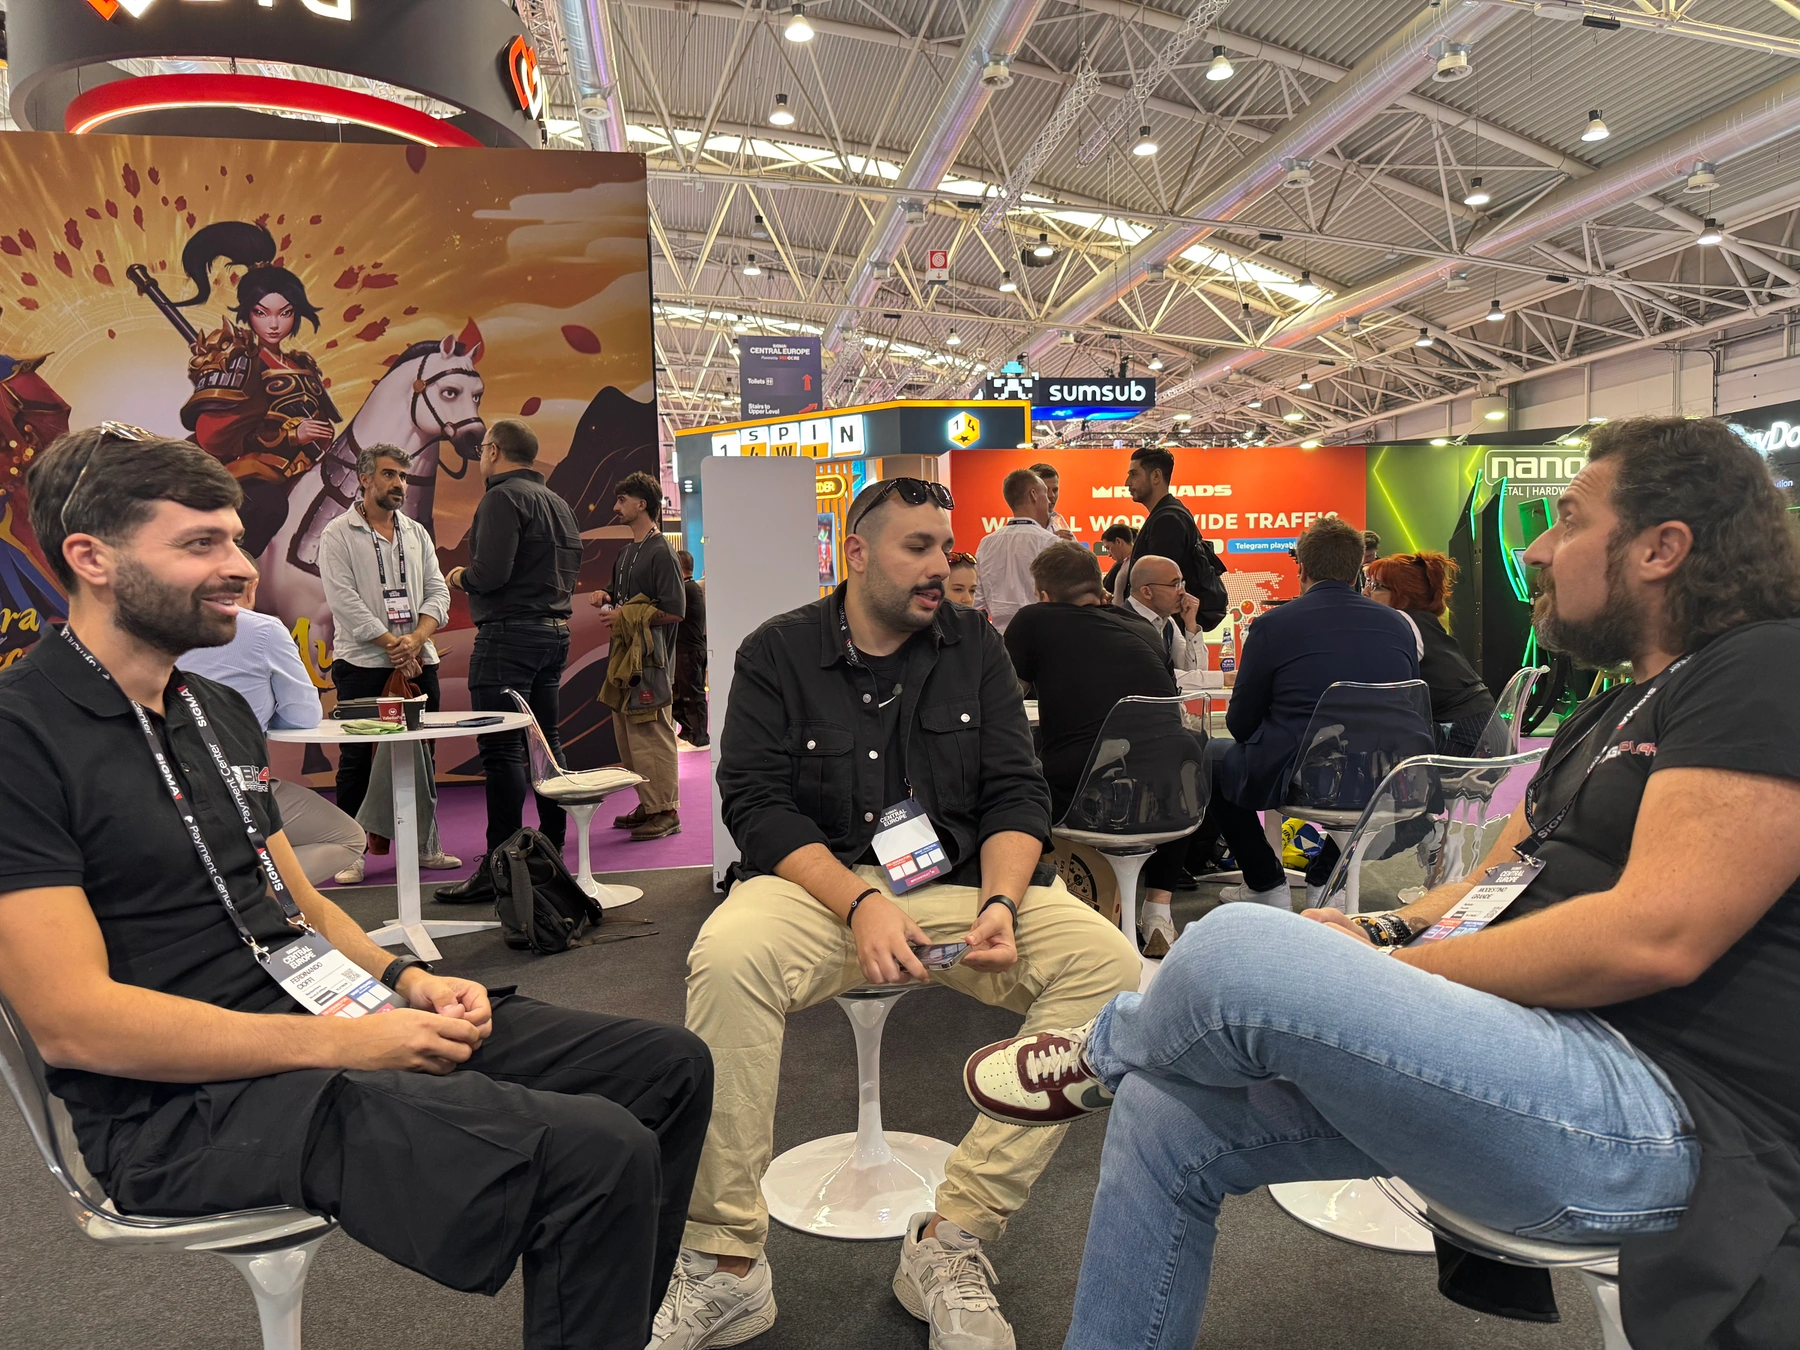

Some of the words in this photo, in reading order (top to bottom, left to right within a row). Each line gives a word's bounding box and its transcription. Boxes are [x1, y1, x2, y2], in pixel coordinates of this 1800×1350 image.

[782, 348, 810, 356] EUROPE
[1049, 381, 1146, 402] sumsub
[1492, 456, 1586, 478] nano
[1502, 486, 1524, 496] ETAL
[1089, 513, 1238, 532] WORIDE
[1245, 511, 1339, 529] TRAFF
[1236, 542, 1269, 550] Telegram
[181, 686, 208, 728] SiGMA
[132, 700, 153, 736] Center
[209, 742, 231, 775] Center
[156, 752, 180, 798] SiGMA
[228, 776, 252, 824] Payment
[880, 808, 907, 824] CENTRAL
[884, 814, 908, 827] EUROPE
[189, 826, 217, 874] Payment
[214, 875, 235, 912] Center
[260, 852, 283, 892] SiGMA
[282, 946, 313, 964] CENTRAL
[289, 951, 316, 969] EUROPE
[290, 962, 323, 984] FERDINANDO
